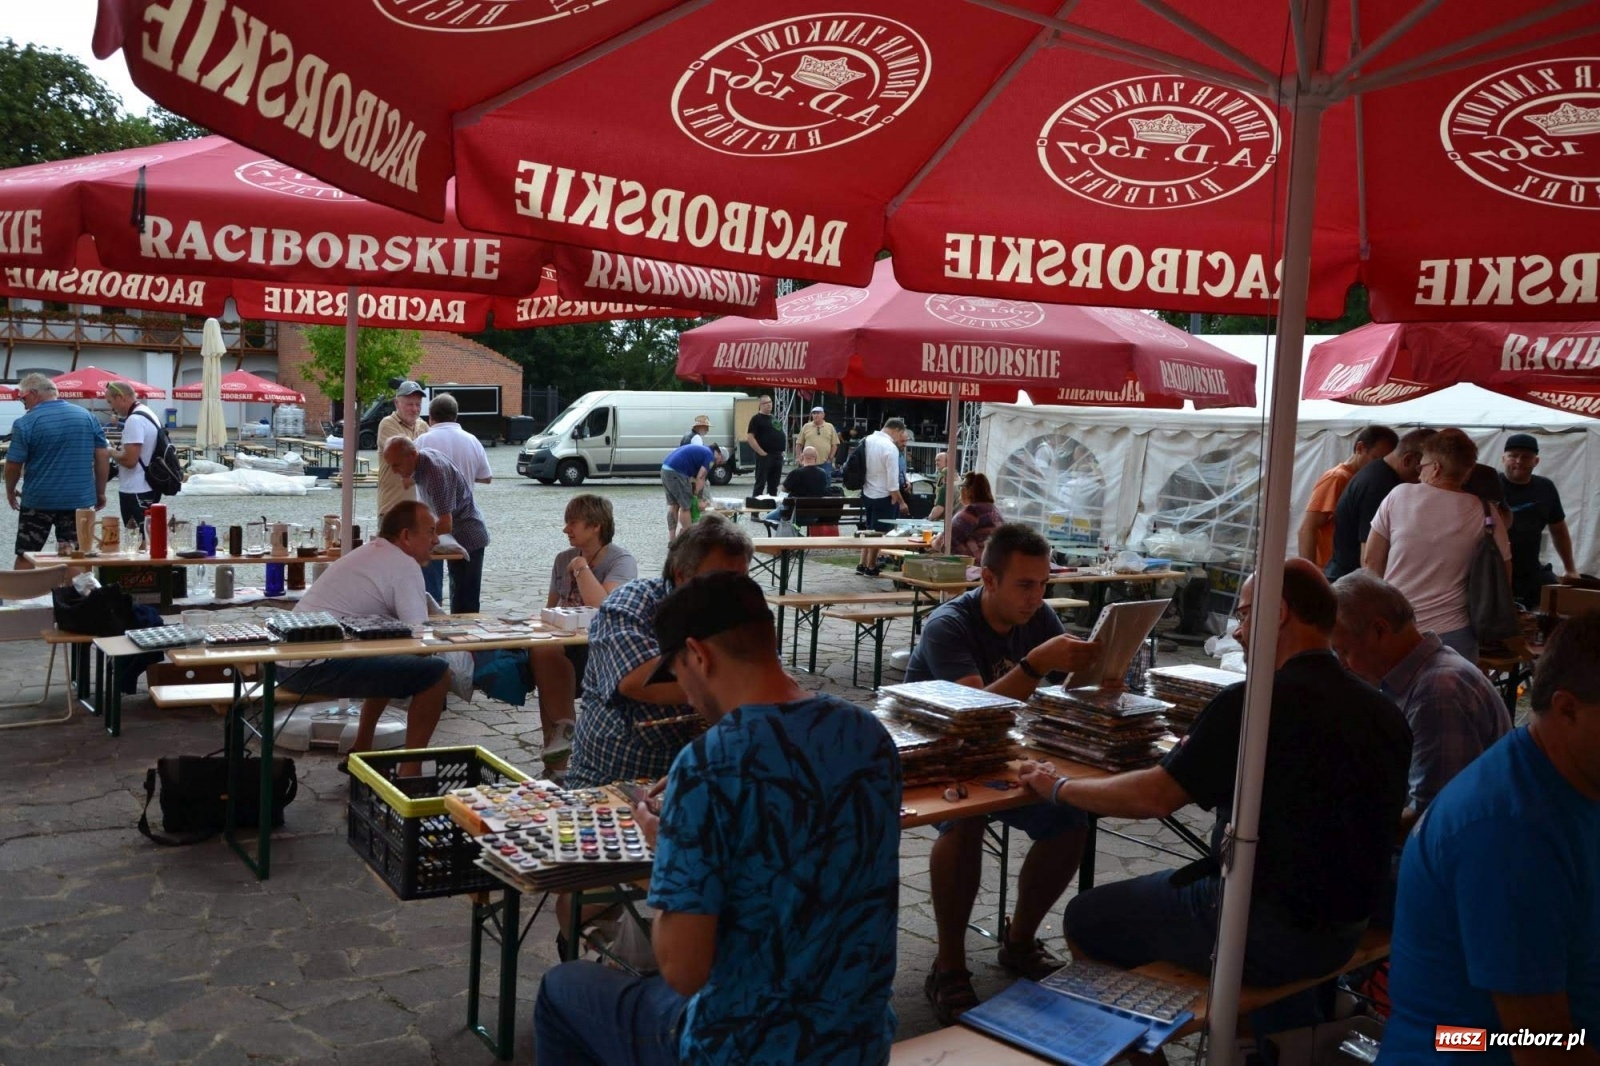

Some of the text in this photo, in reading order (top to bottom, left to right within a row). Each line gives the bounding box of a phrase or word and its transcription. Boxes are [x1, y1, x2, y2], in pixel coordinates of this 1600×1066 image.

[140, 215, 501, 280] RACIBORSKIE
[584, 250, 761, 307] RACIBORSKIE
[713, 341, 809, 370] RACIBORSKIE
[921, 342, 1061, 379] RACIBORSKIE
[1159, 360, 1229, 395] RACIBORSKIE
